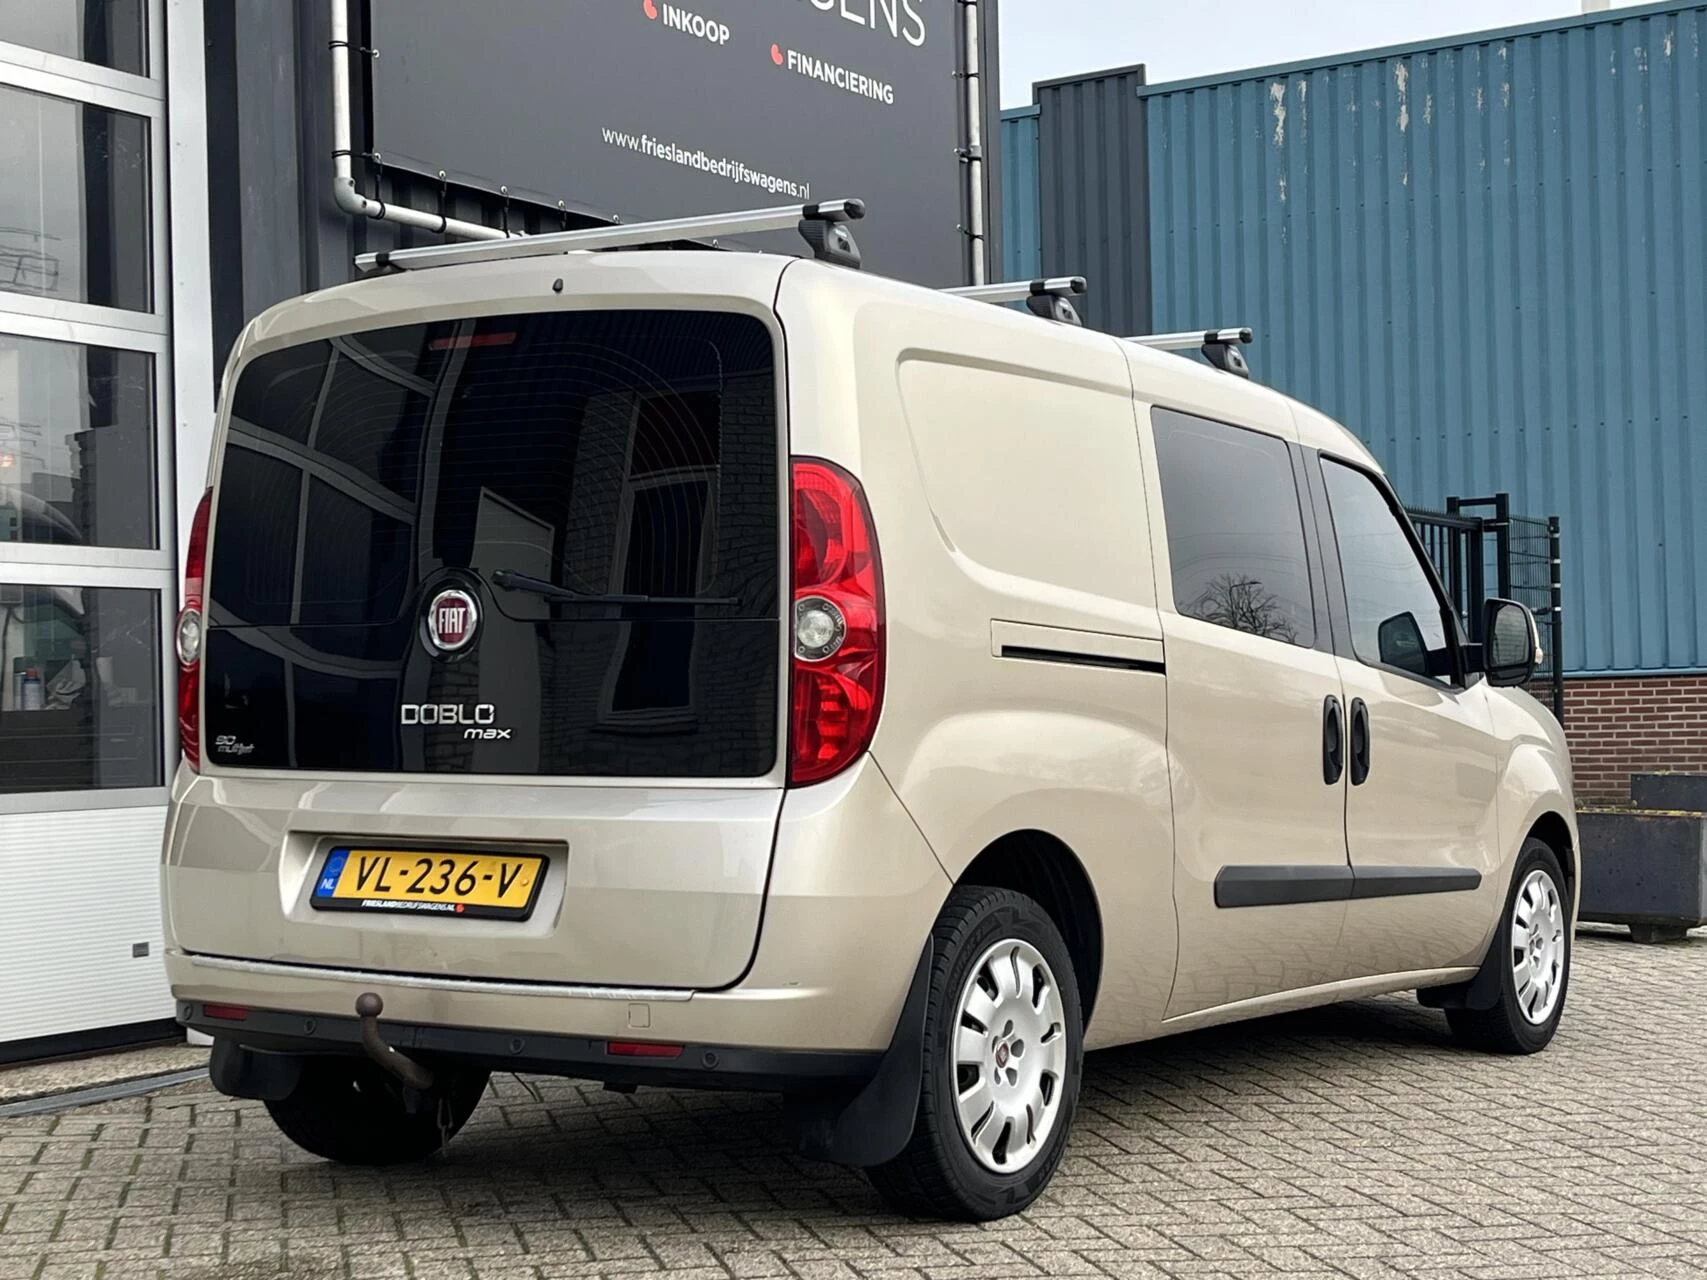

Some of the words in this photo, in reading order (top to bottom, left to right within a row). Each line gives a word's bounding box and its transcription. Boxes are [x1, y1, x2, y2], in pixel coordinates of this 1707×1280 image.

[662, 3, 730, 46] INKOOP
[808, 0, 926, 47] NS
[788, 49, 894, 104] FINANCIERING
[601, 127, 810, 200] www.frieslandbedrijfswagens.nl
[438, 607, 466, 634] FIAT
[463, 728, 512, 739] max
[320, 878, 335, 890] NL
[356, 856, 523, 898] VL-236-V
